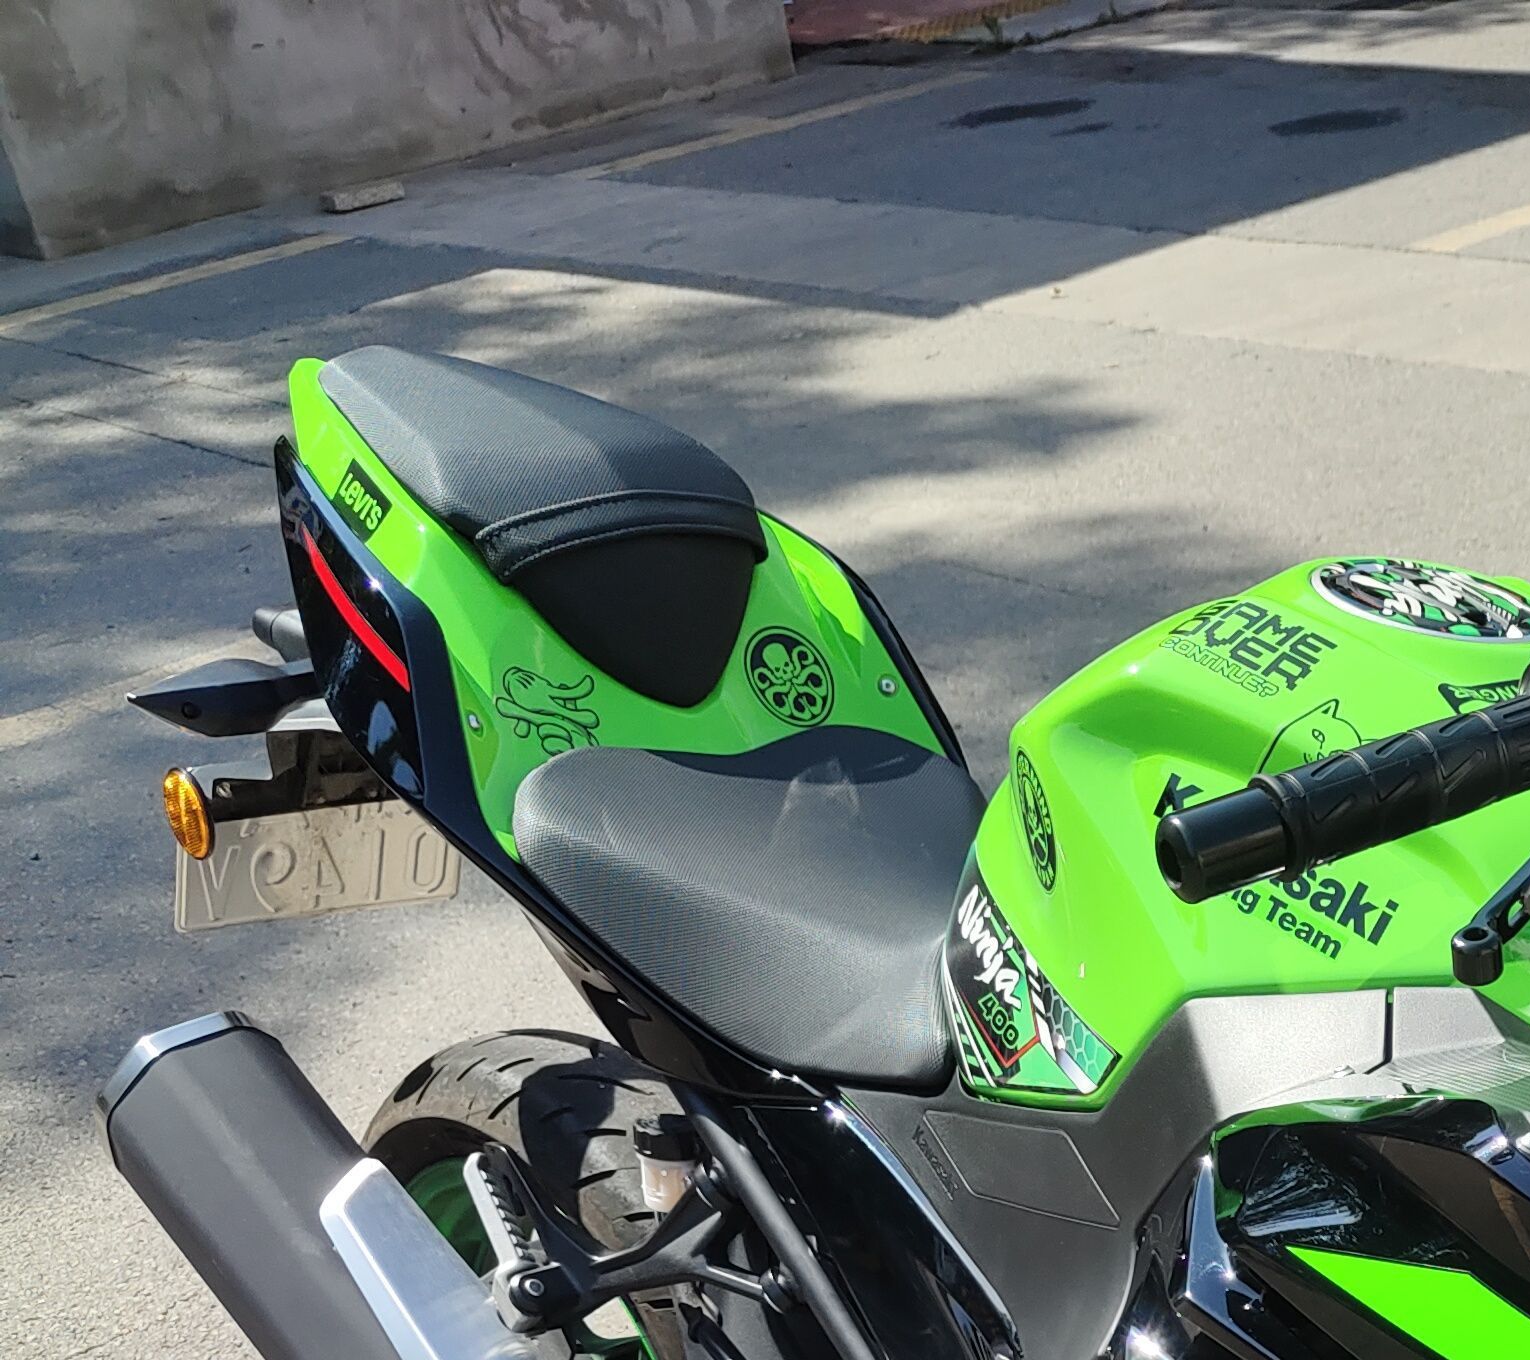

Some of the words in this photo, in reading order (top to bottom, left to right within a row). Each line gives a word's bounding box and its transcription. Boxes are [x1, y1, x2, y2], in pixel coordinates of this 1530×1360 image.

[1168, 617, 1312, 691] OVER
[1193, 600, 1338, 664] GAME
[1158, 635, 1280, 698] CONTINUE?
[1448, 685, 1519, 701] ANGER
[1153, 772, 1400, 946] Ksaki
[958, 884, 1023, 1012] Ninja
[1265, 894, 1342, 960] Team
[978, 992, 1020, 1049] 400
